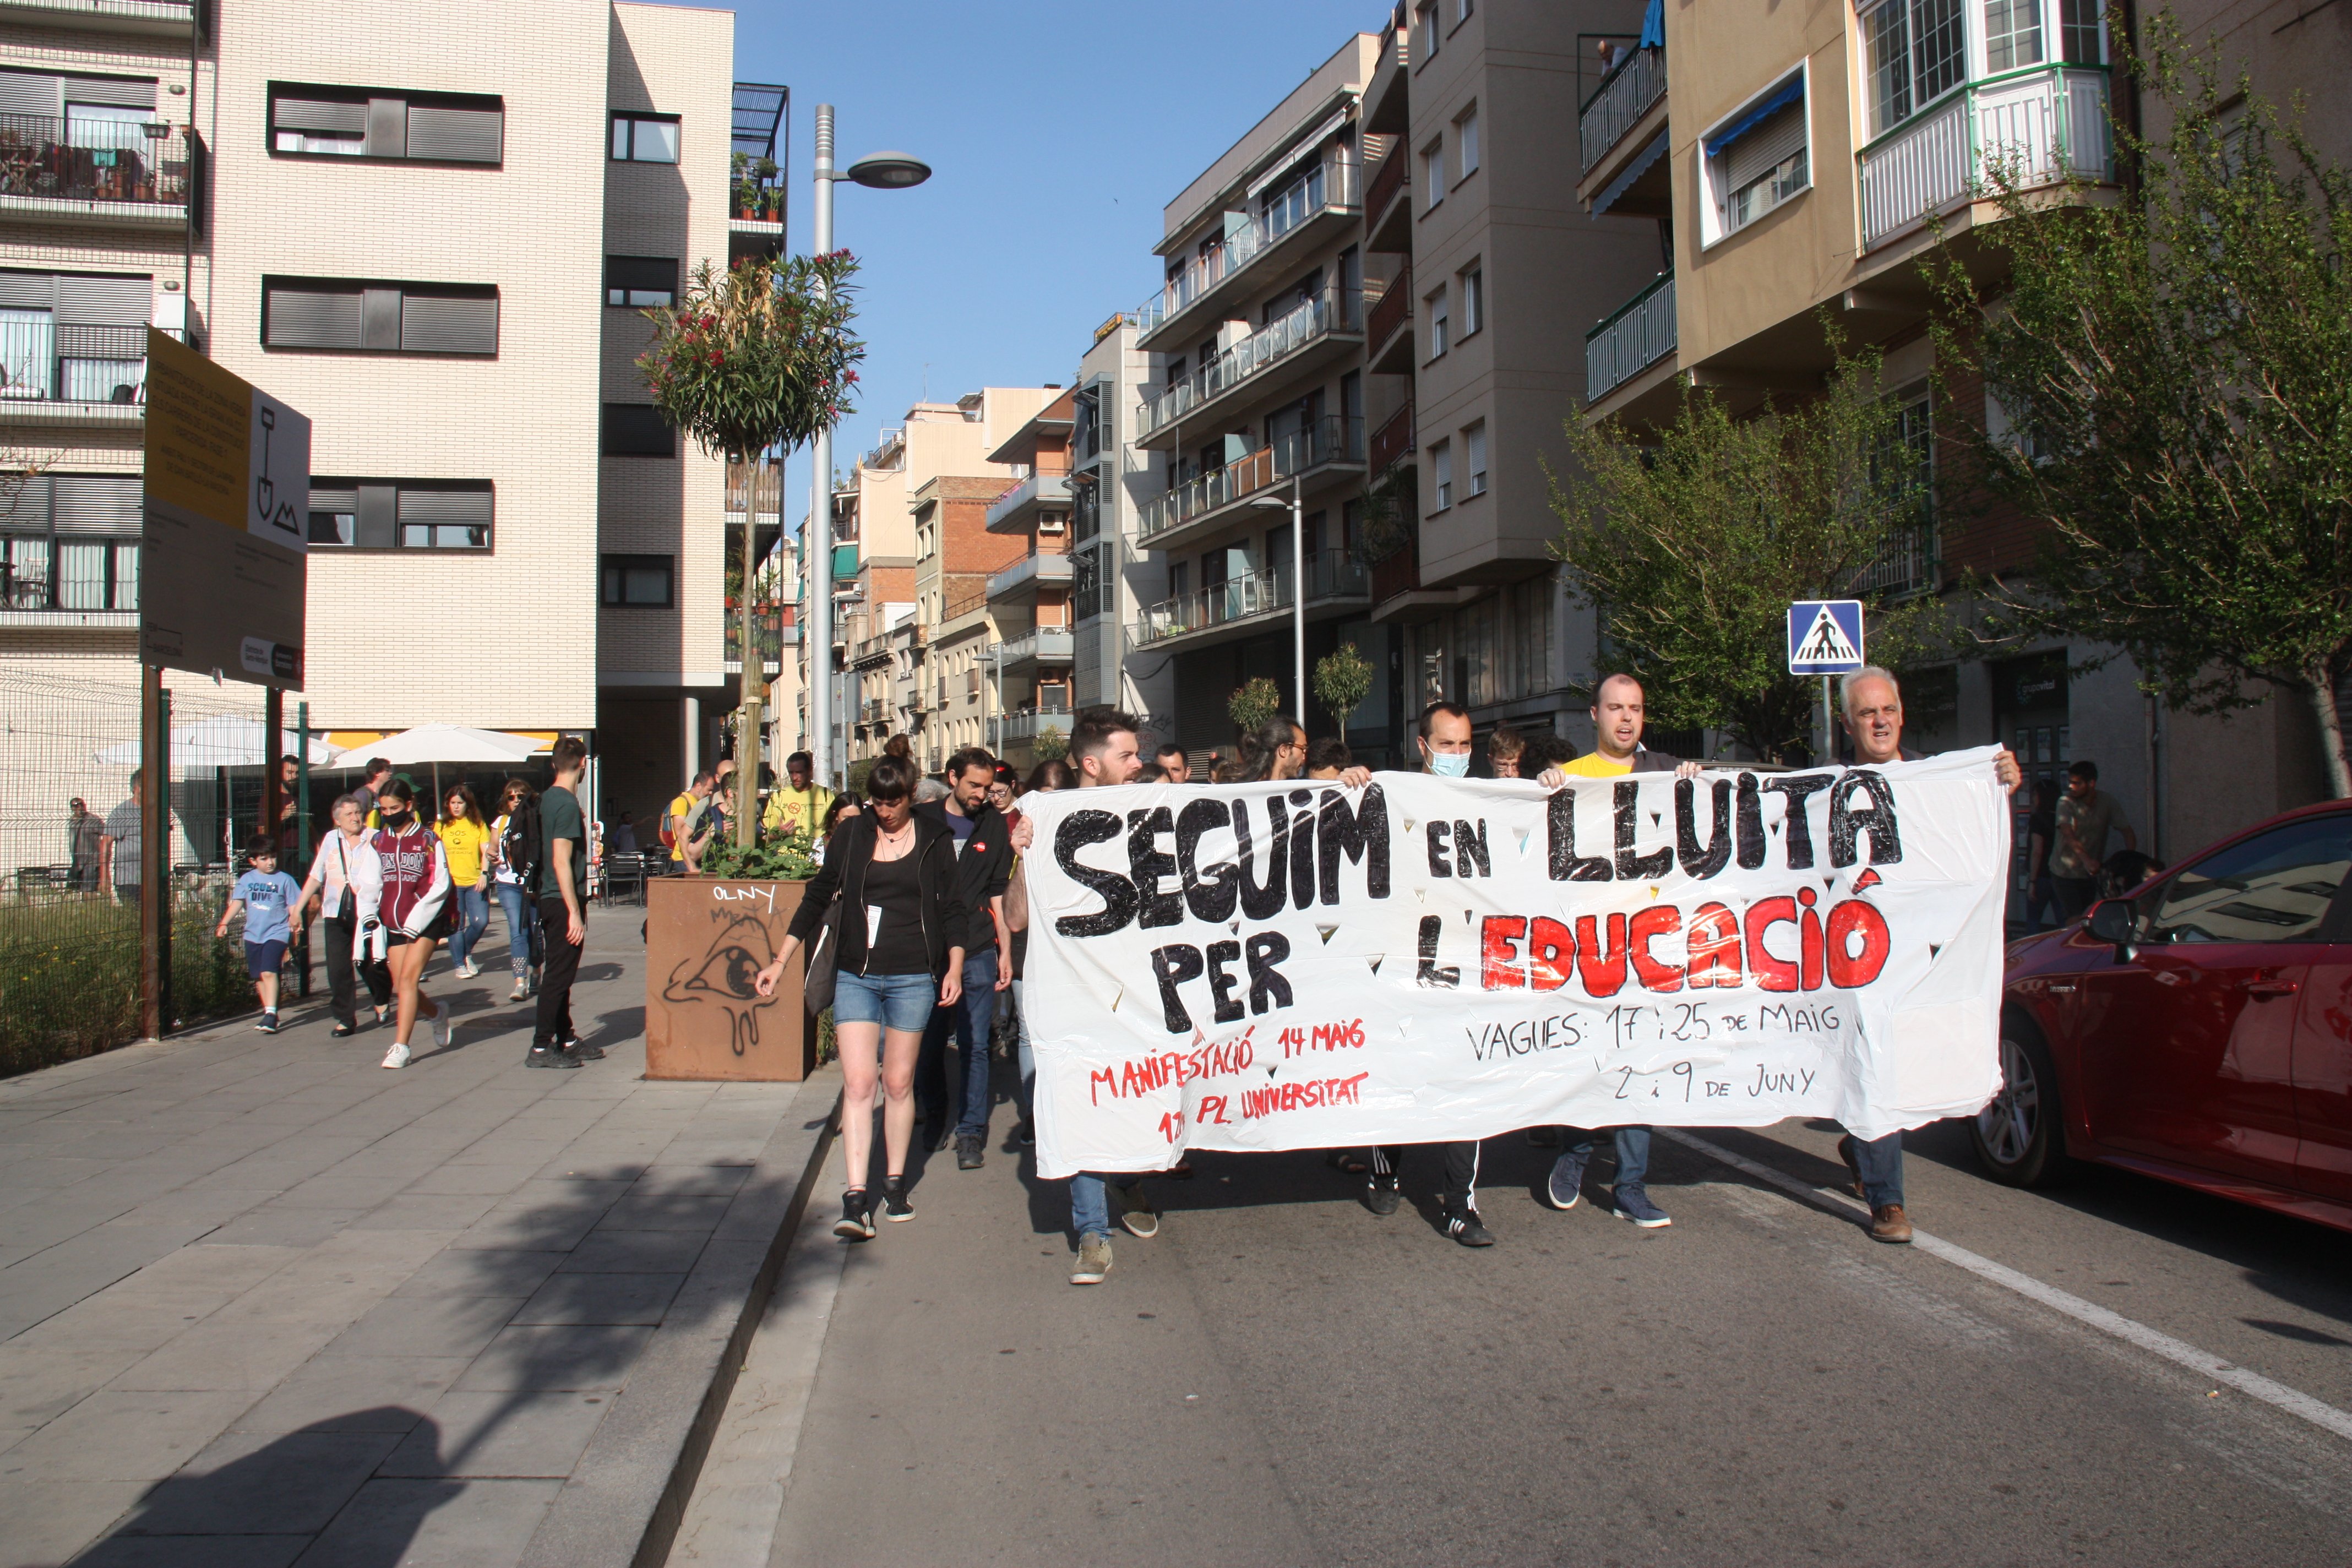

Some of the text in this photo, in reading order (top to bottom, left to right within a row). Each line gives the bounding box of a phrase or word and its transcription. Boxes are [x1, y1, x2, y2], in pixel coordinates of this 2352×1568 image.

[2022, 679, 2056, 695] grupovital
[1427, 818, 1491, 878] EN
[247, 883, 279, 894] SCUBA
[713, 884, 776, 914] OLNY
[1150, 930, 1294, 1034] PER
[1277, 1027, 1306, 1059] 14
[1605, 1004, 1643, 1049] 17
[1670, 1002, 1711, 1041] 25
[1614, 1064, 1635, 1099] 2
[1673, 1061, 1692, 1103] 9
[1705, 1080, 1732, 1097] DE
[1748, 1063, 1816, 1097] JUNY
